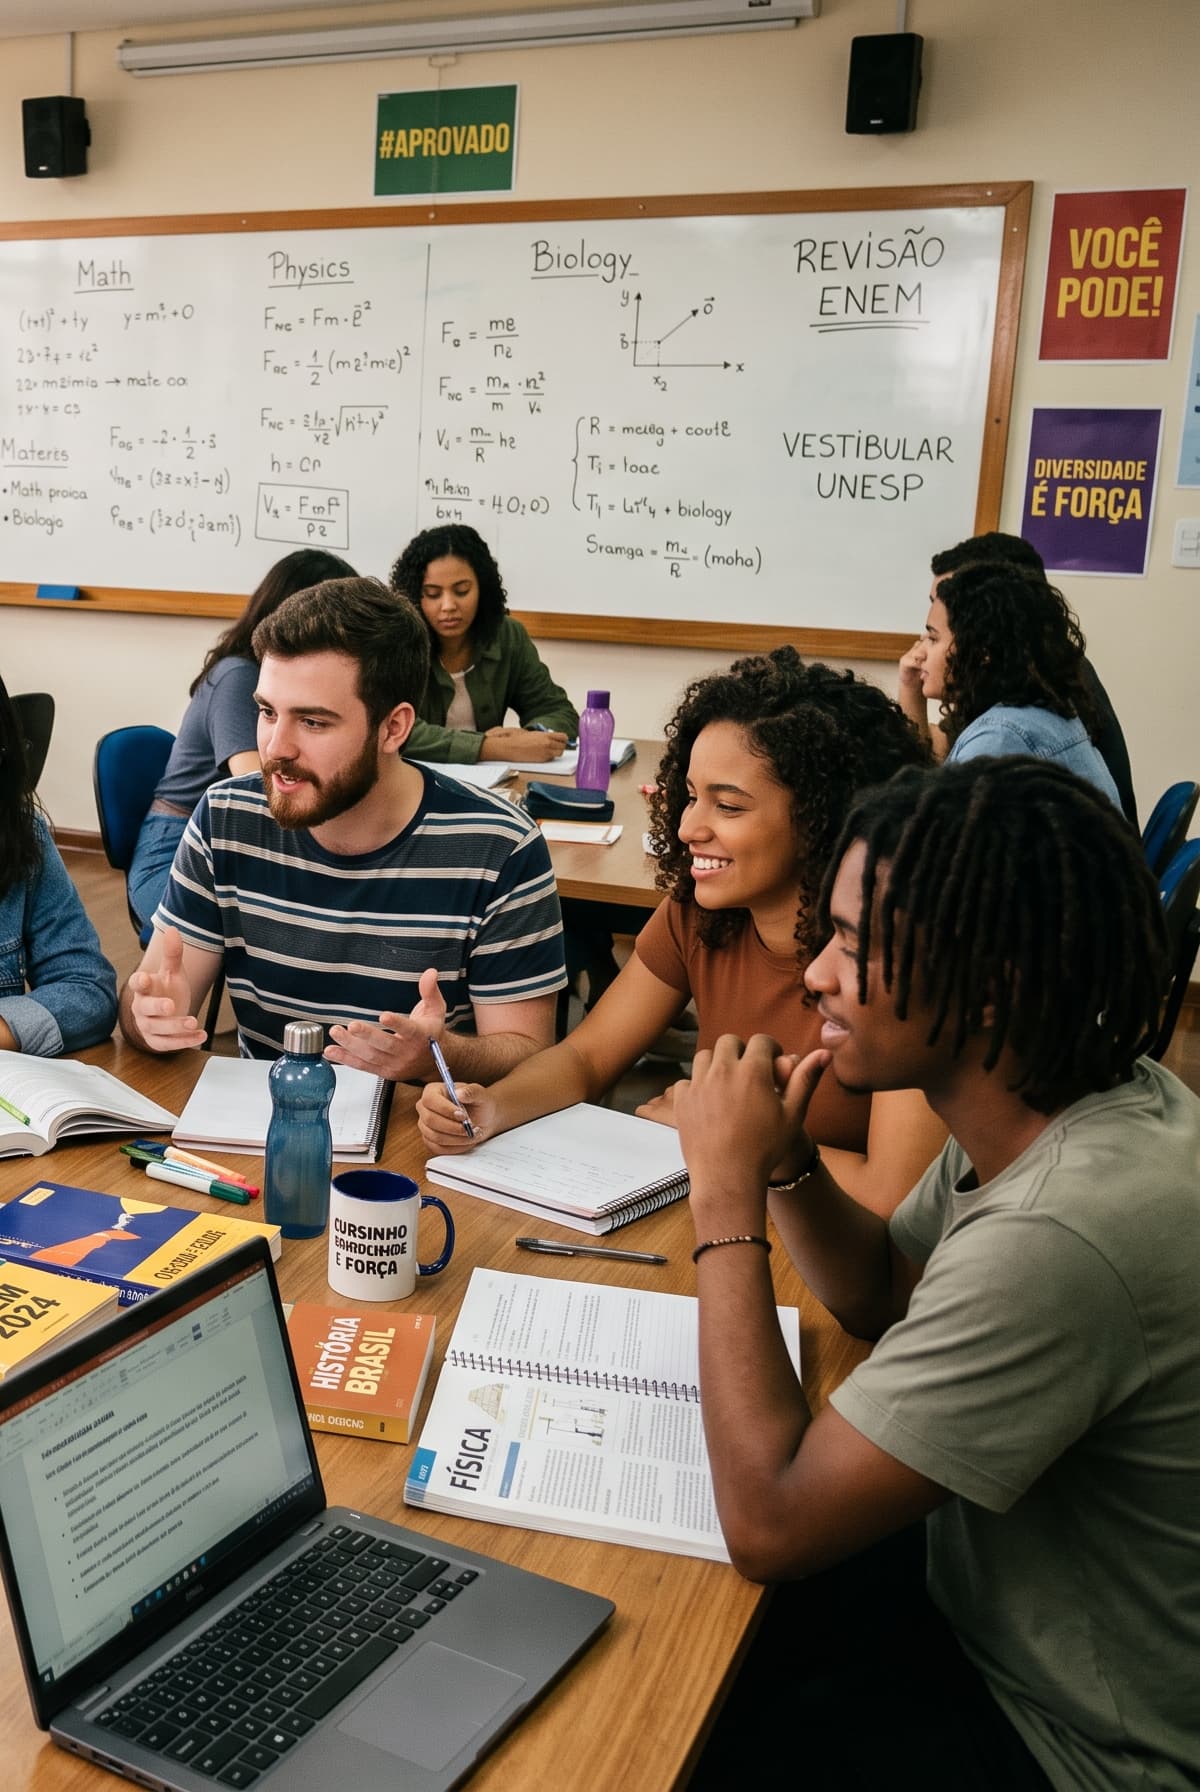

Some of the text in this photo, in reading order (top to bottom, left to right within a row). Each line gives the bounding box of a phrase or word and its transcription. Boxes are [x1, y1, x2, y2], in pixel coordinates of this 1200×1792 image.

[379, 123, 510, 159] #APROVADO
[793, 226, 946, 273] REVISÃO
[1069, 216, 1162, 269] VOCÊ
[78, 259, 131, 287] Math
[267, 251, 351, 289] Physics
[531, 239, 632, 283] Biology
[819, 282, 923, 316] ENEM
[1057, 276, 1164, 318] PODE!
[590, 416, 601, 435] R
[782, 430, 954, 463] VESTIBULAR
[816, 472, 924, 502] UNESP
[1034, 458, 1148, 482] DIVERSIDADE
[11, 480, 42, 497] Math
[1031, 481, 1143, 525] É FORÇA
[678, 499, 732, 526] biology
[334, 1217, 408, 1241] CURSINHO
[345, 1256, 398, 1280] FORÇA
[310, 1317, 361, 1390] HISTÓRIA
[344, 1327, 396, 1396] BRASIL
[446, 1428, 492, 1492] FÍSICA
